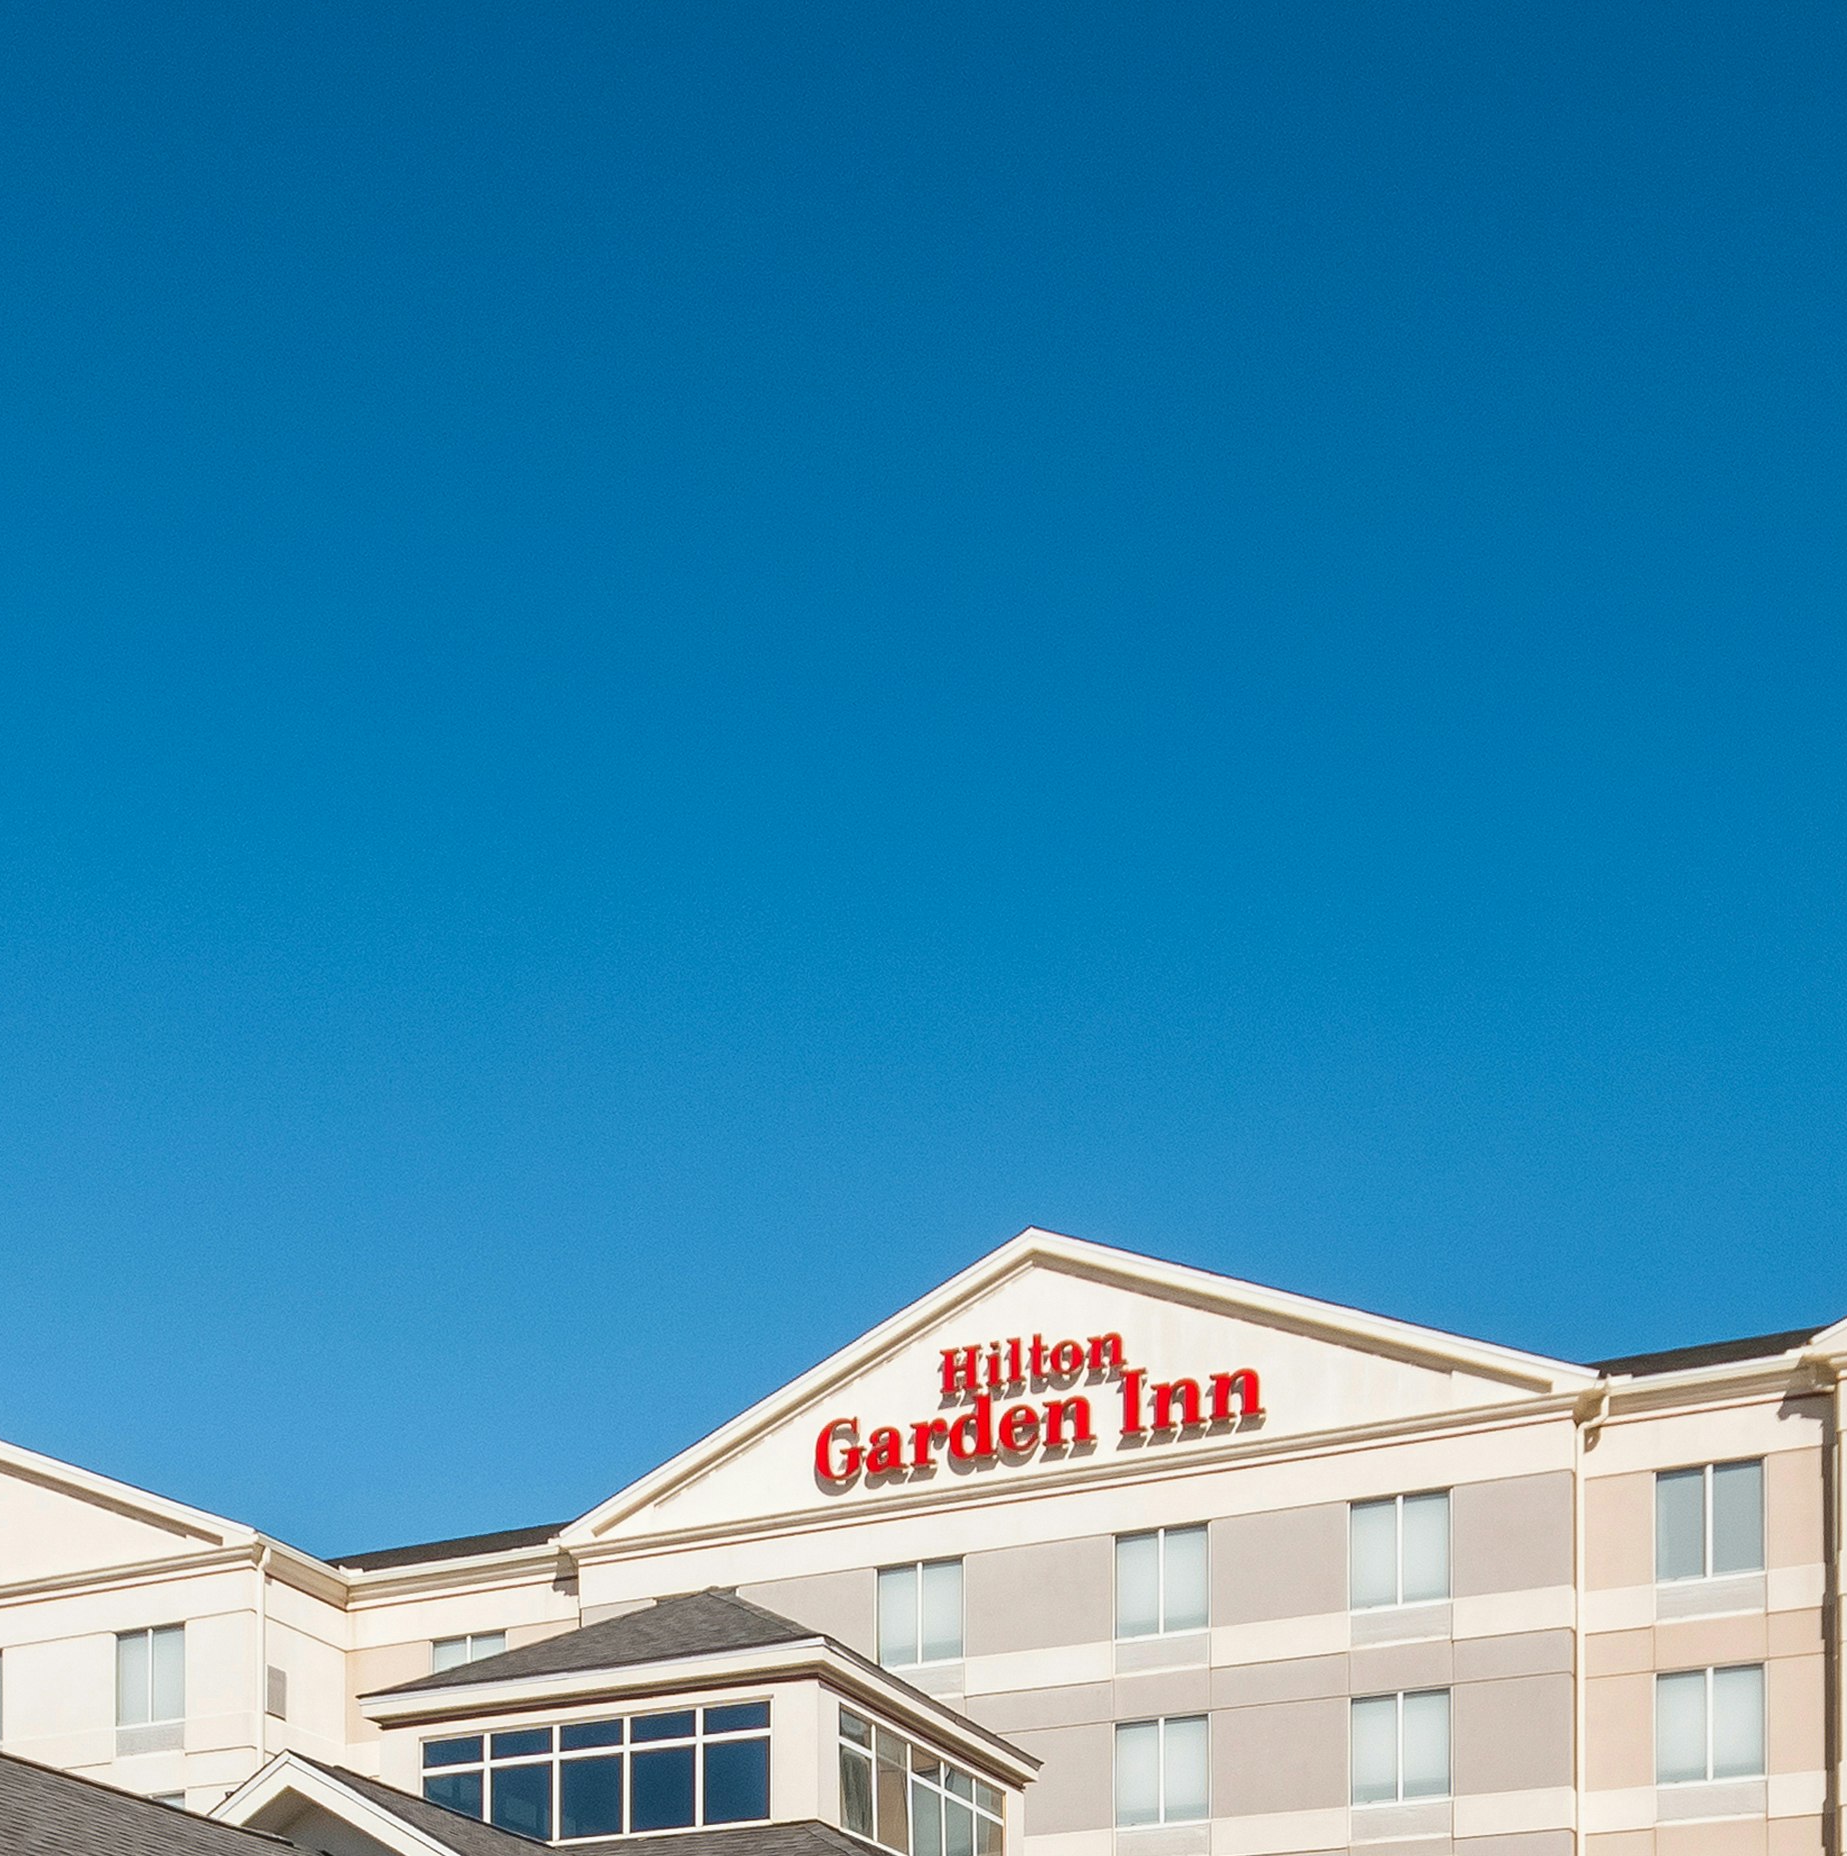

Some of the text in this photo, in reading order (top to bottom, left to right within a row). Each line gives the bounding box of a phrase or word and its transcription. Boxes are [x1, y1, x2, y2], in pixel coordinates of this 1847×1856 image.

[939, 1331, 1128, 1394] Hilton
[814, 1366, 1267, 1481] Garden Inn
